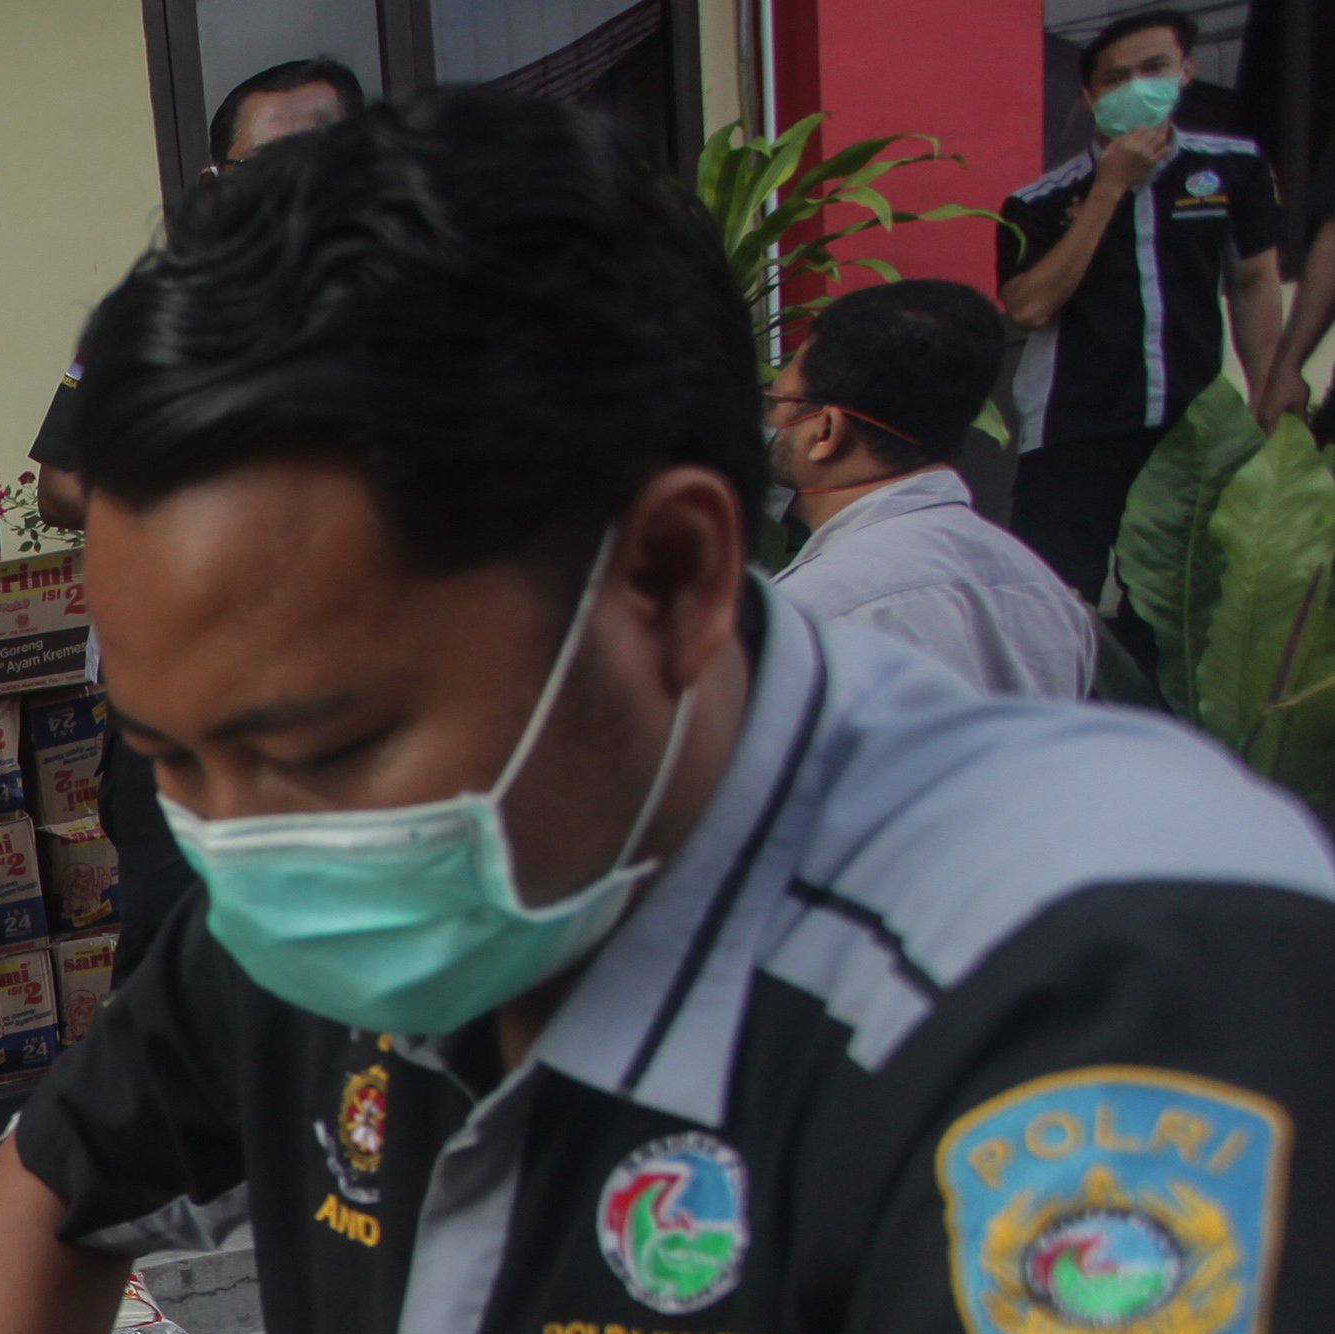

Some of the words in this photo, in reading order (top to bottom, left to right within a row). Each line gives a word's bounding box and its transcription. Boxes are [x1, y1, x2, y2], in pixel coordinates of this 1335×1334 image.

[42, 587, 61, 602] ISI
[64, 582, 88, 616] 2
[0, 638, 44, 660] Goreng
[6, 653, 41, 674] Ayam
[6, 852, 27, 876] 2
[4, 915, 32, 934] 24
[23, 981, 43, 1006] 2
[967, 1101, 1251, 1191] POLRI
